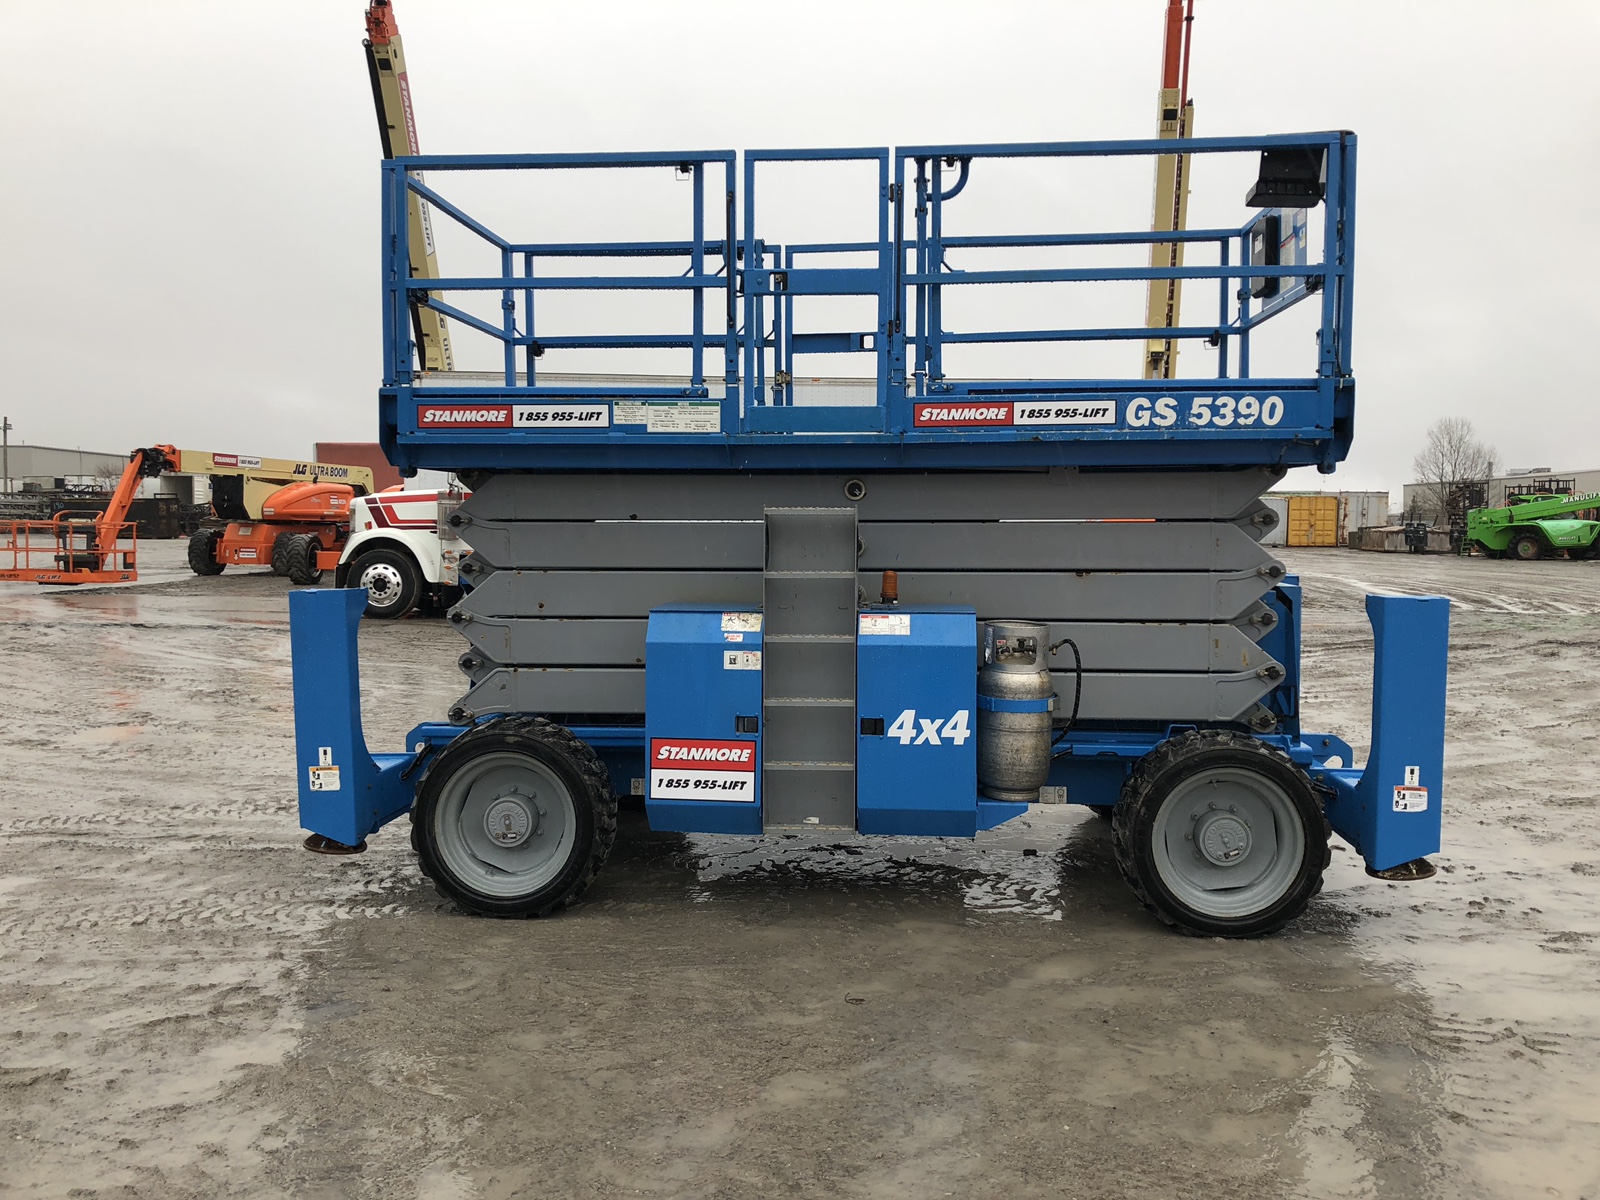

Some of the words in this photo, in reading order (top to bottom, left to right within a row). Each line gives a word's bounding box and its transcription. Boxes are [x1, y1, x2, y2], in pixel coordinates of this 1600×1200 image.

[400, 79, 417, 156] STANMOR
[422, 409, 508, 423] STANMORE
[518, 411, 524, 422] 1
[525, 411, 549, 422] 855
[551, 411, 603, 422] 955-LIFT
[919, 407, 1009, 422] STANMORE
[1019, 409, 1025, 419] 1
[1027, 408, 1051, 419] 855
[1053, 407, 1110, 419] 955-LIFT
[1125, 397, 1178, 427] GS
[1188, 395, 1284, 427] 5390
[292, 463, 308, 475] JLG
[309, 464, 329, 476] ULTRA
[329, 466, 348, 478] BOOM
[887, 709, 971, 746] 4x4
[656, 745, 752, 763] STANMORE
[657, 778, 664, 788] 1
[665, 778, 690, 789] 855
[693, 779, 748, 791] 955-LIFT
